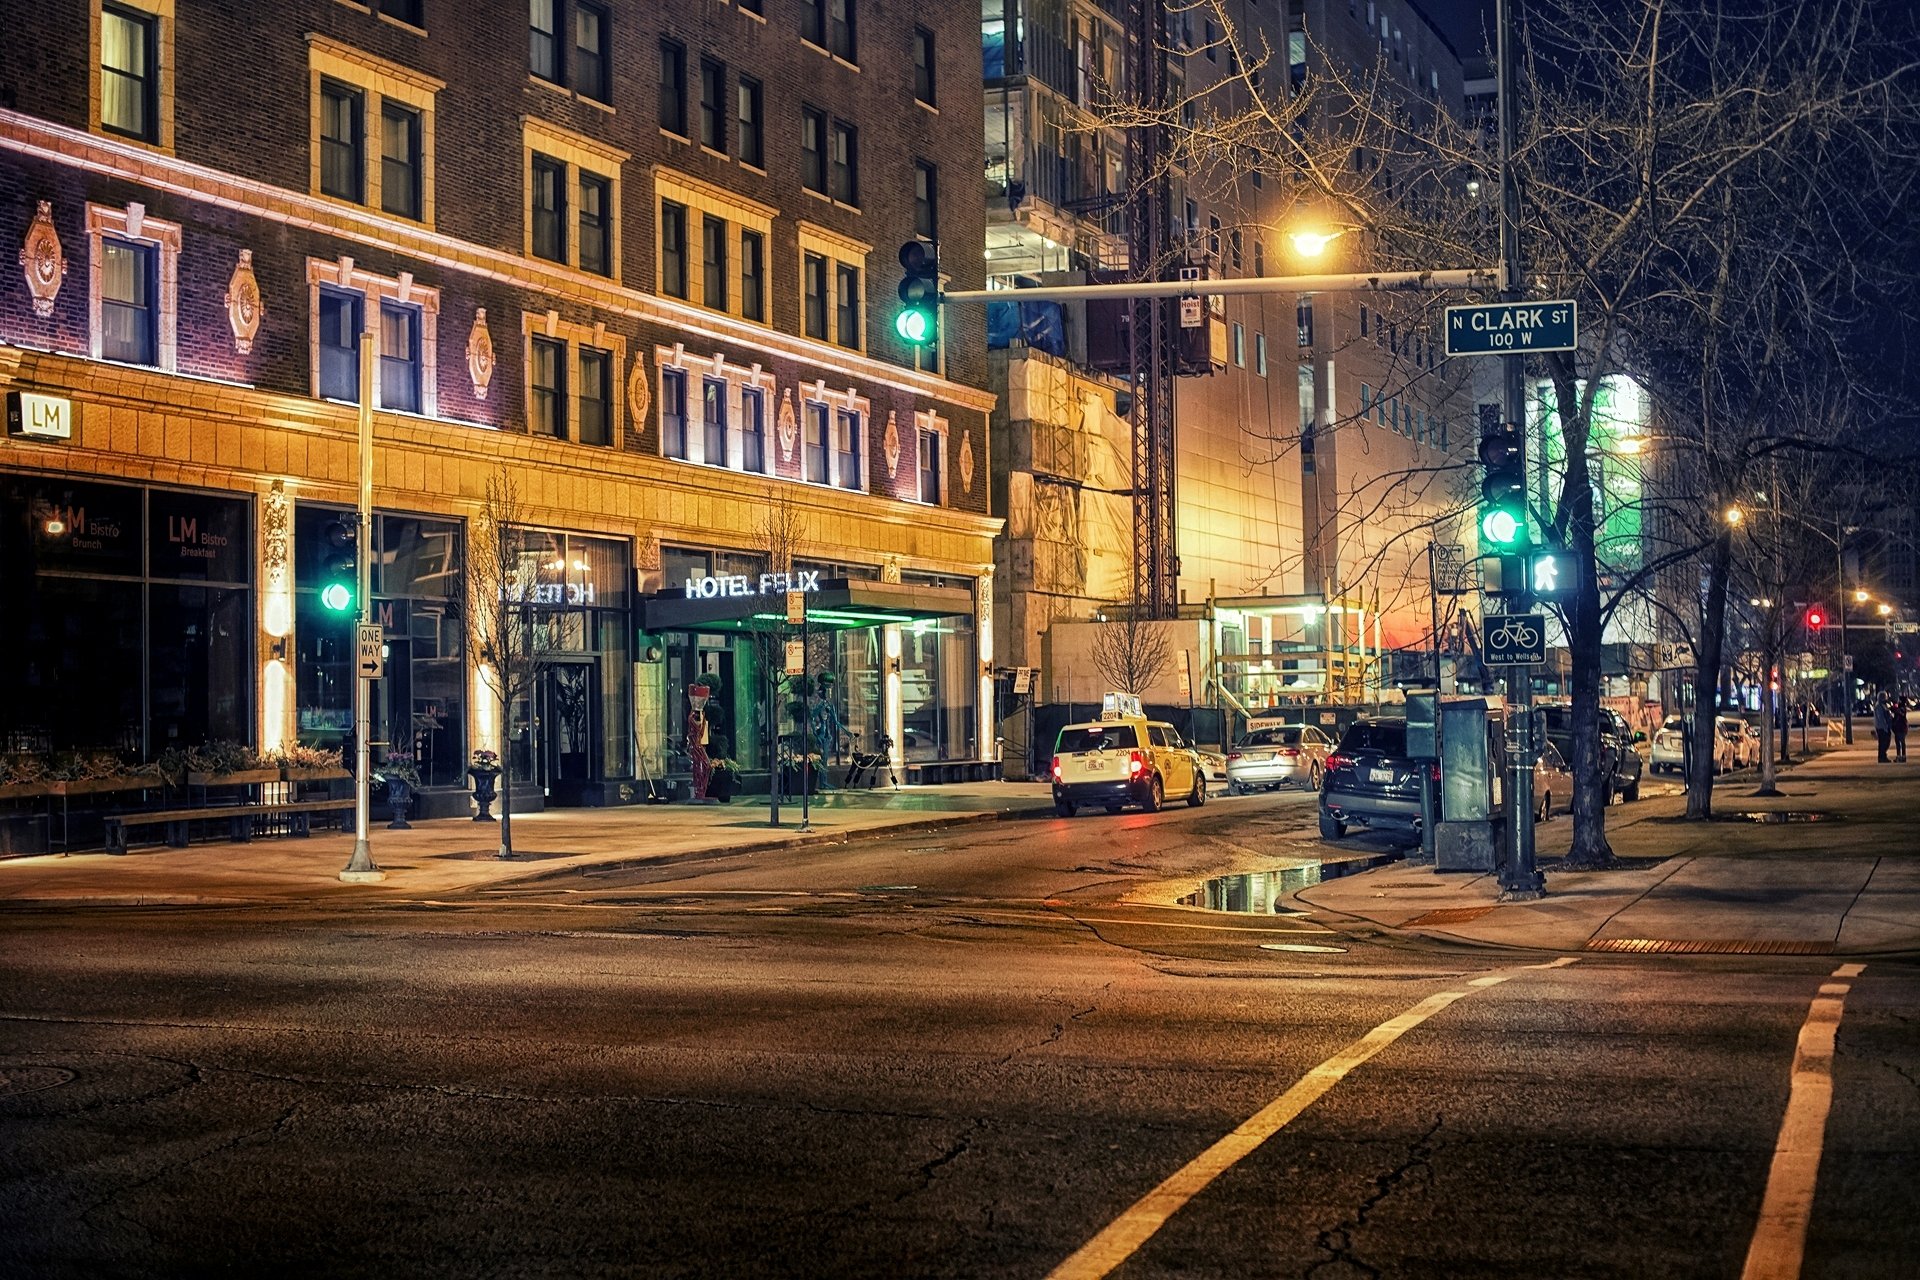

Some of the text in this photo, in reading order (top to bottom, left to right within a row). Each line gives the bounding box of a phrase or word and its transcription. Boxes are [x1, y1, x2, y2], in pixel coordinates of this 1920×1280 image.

[1453, 308, 1568, 331] N CLARK ST
[1489, 332, 1532, 347] 100 W
[33, 402, 59, 430] LM
[90, 522, 120, 538] Bistro
[169, 515, 228, 547] LM Bistro
[72, 537, 102, 550] Brunch
[181, 546, 216, 559] Breakfast
[685, 570, 819, 599] HOTEL FELIX
[361, 630, 380, 643] ONE
[361, 645, 380, 657] WAY
[1490, 653, 1505, 661] West
[1506, 653, 1513, 661] to
[1515, 652, 1529, 661] Wells
[1103, 712, 1117, 720] 2204
